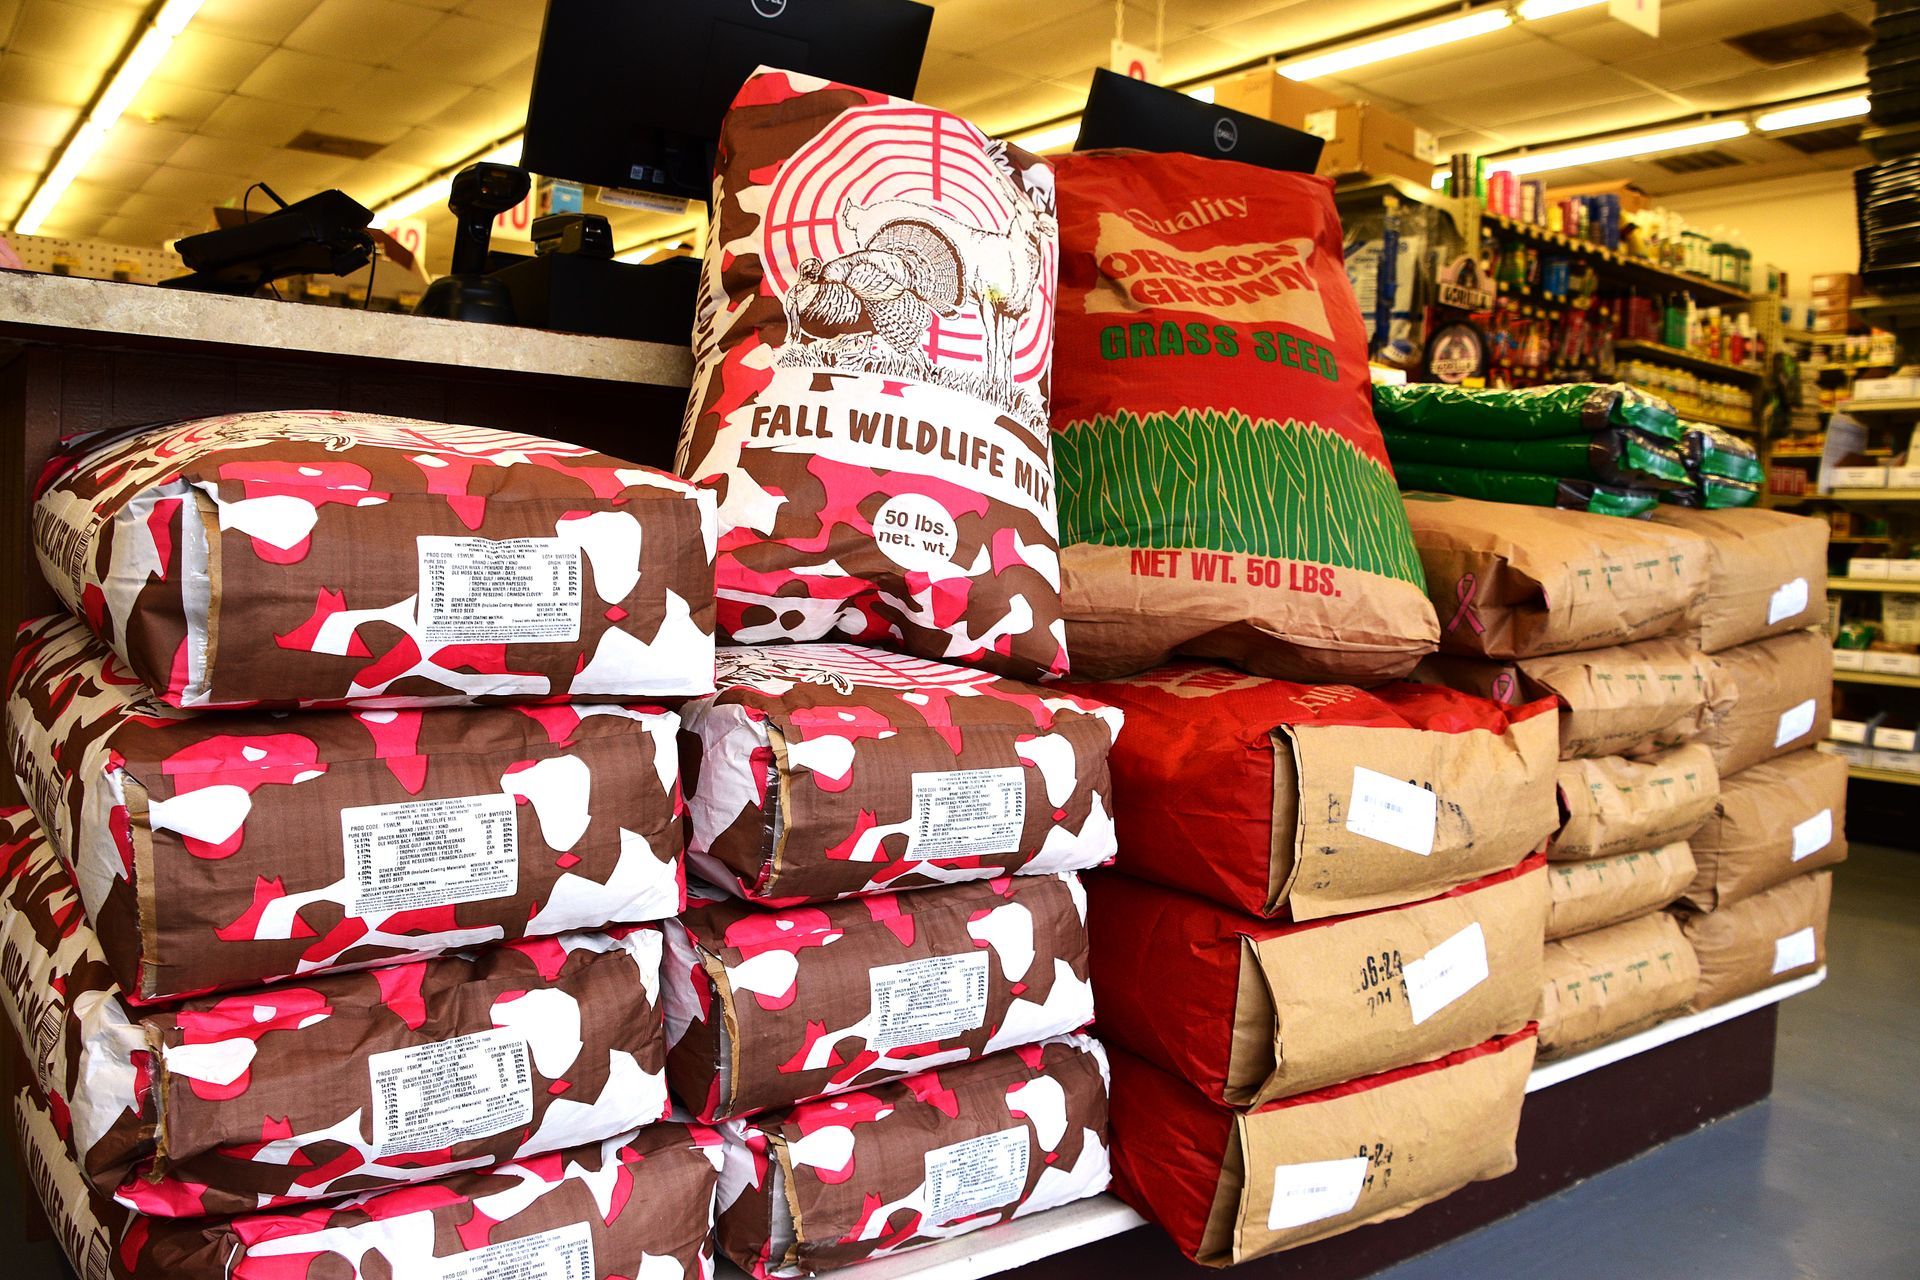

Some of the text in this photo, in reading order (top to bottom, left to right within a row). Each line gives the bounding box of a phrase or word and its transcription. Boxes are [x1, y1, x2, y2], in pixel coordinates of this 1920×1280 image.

[1124, 196, 1249, 235] Quality
[1100, 244, 1299, 283] OREGON
[1130, 261, 1316, 307] GROWN
[1100, 320, 1339, 382] GRASS SEED
[751, 404, 1050, 512] FALL WILDLIFE MIX
[878, 530, 950, 557] net. wt.
[884, 509, 949, 537] 50 lbs.
[1130, 549, 1342, 598] NET WT. 50 LBS.
